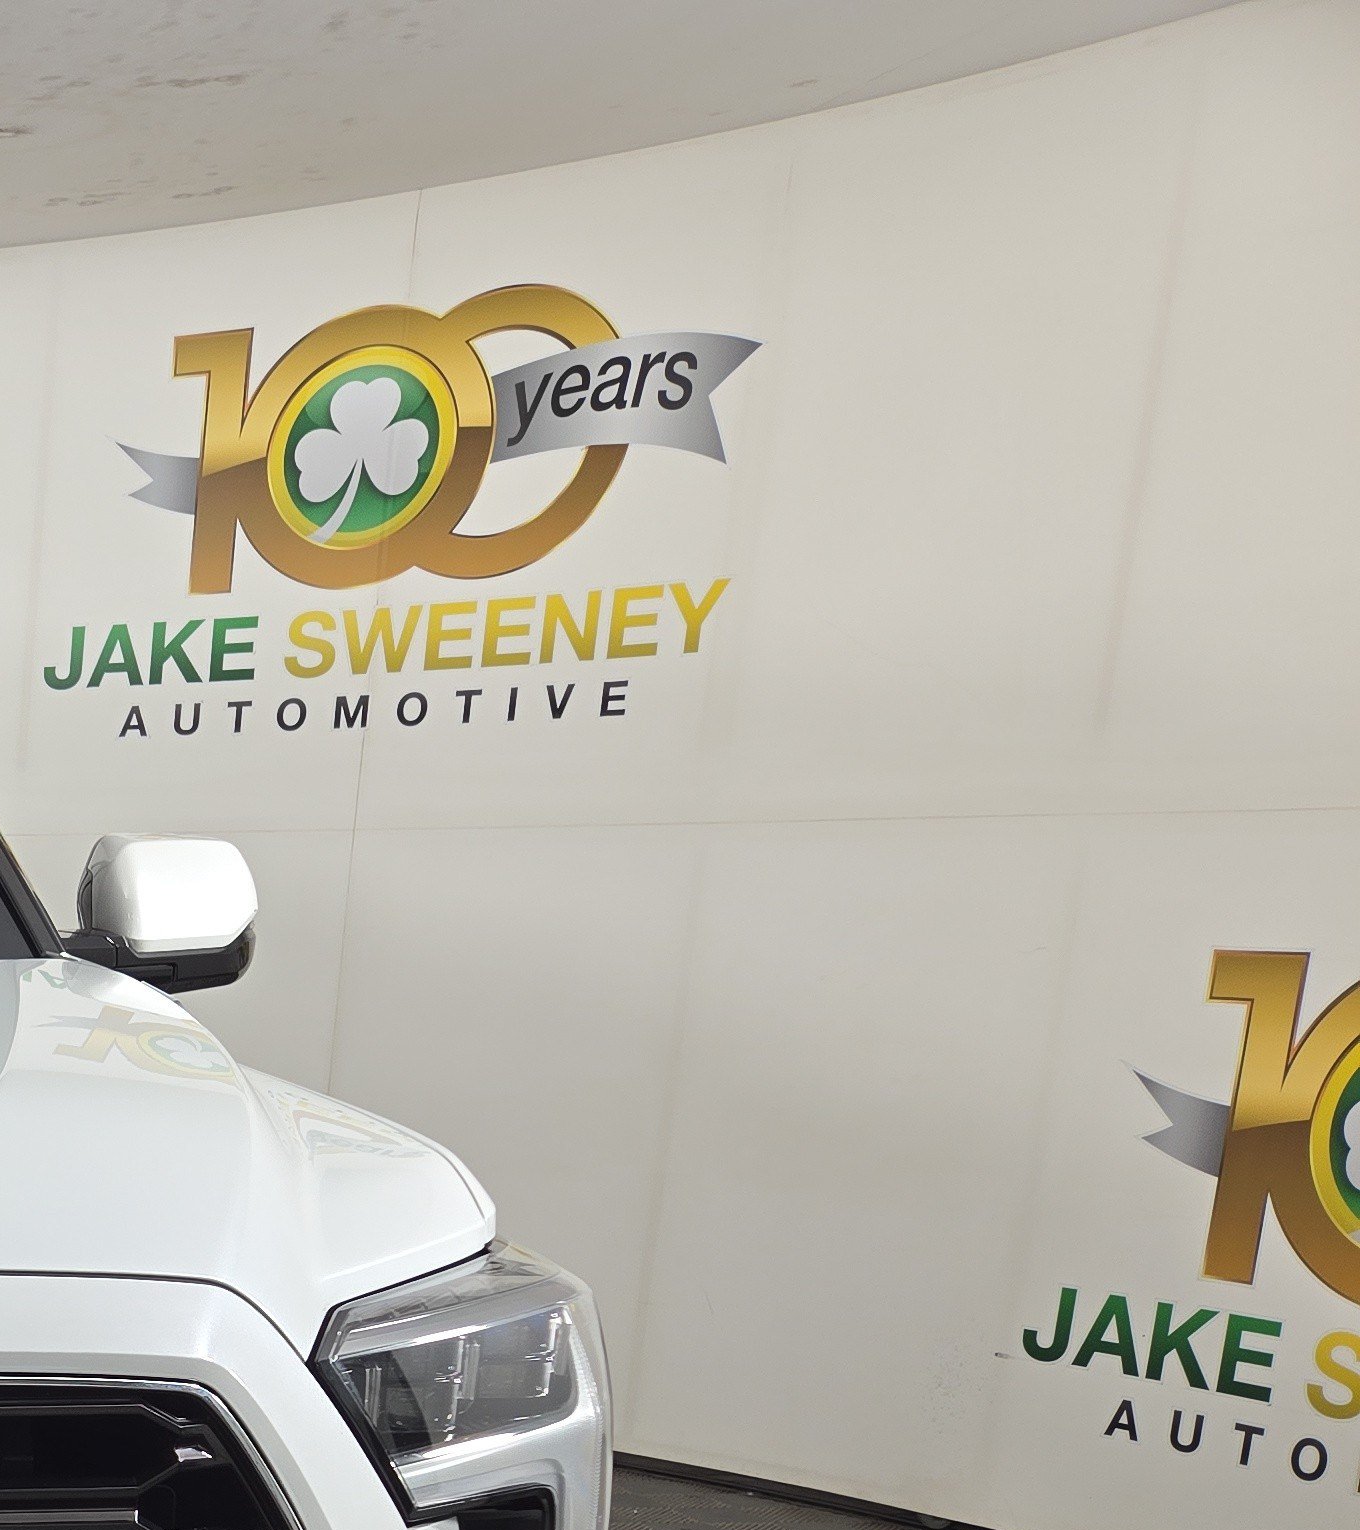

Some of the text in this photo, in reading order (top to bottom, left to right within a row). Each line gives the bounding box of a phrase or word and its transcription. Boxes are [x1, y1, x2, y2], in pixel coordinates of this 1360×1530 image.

[506, 350, 697, 446] years
[43, 578, 731, 690] JAKE SWEENEY
[118, 680, 629, 739] AUTOMOTIVE
[1022, 1287, 1283, 1403] JAKE
[1103, 1400, 1360, 1492] AUTO
